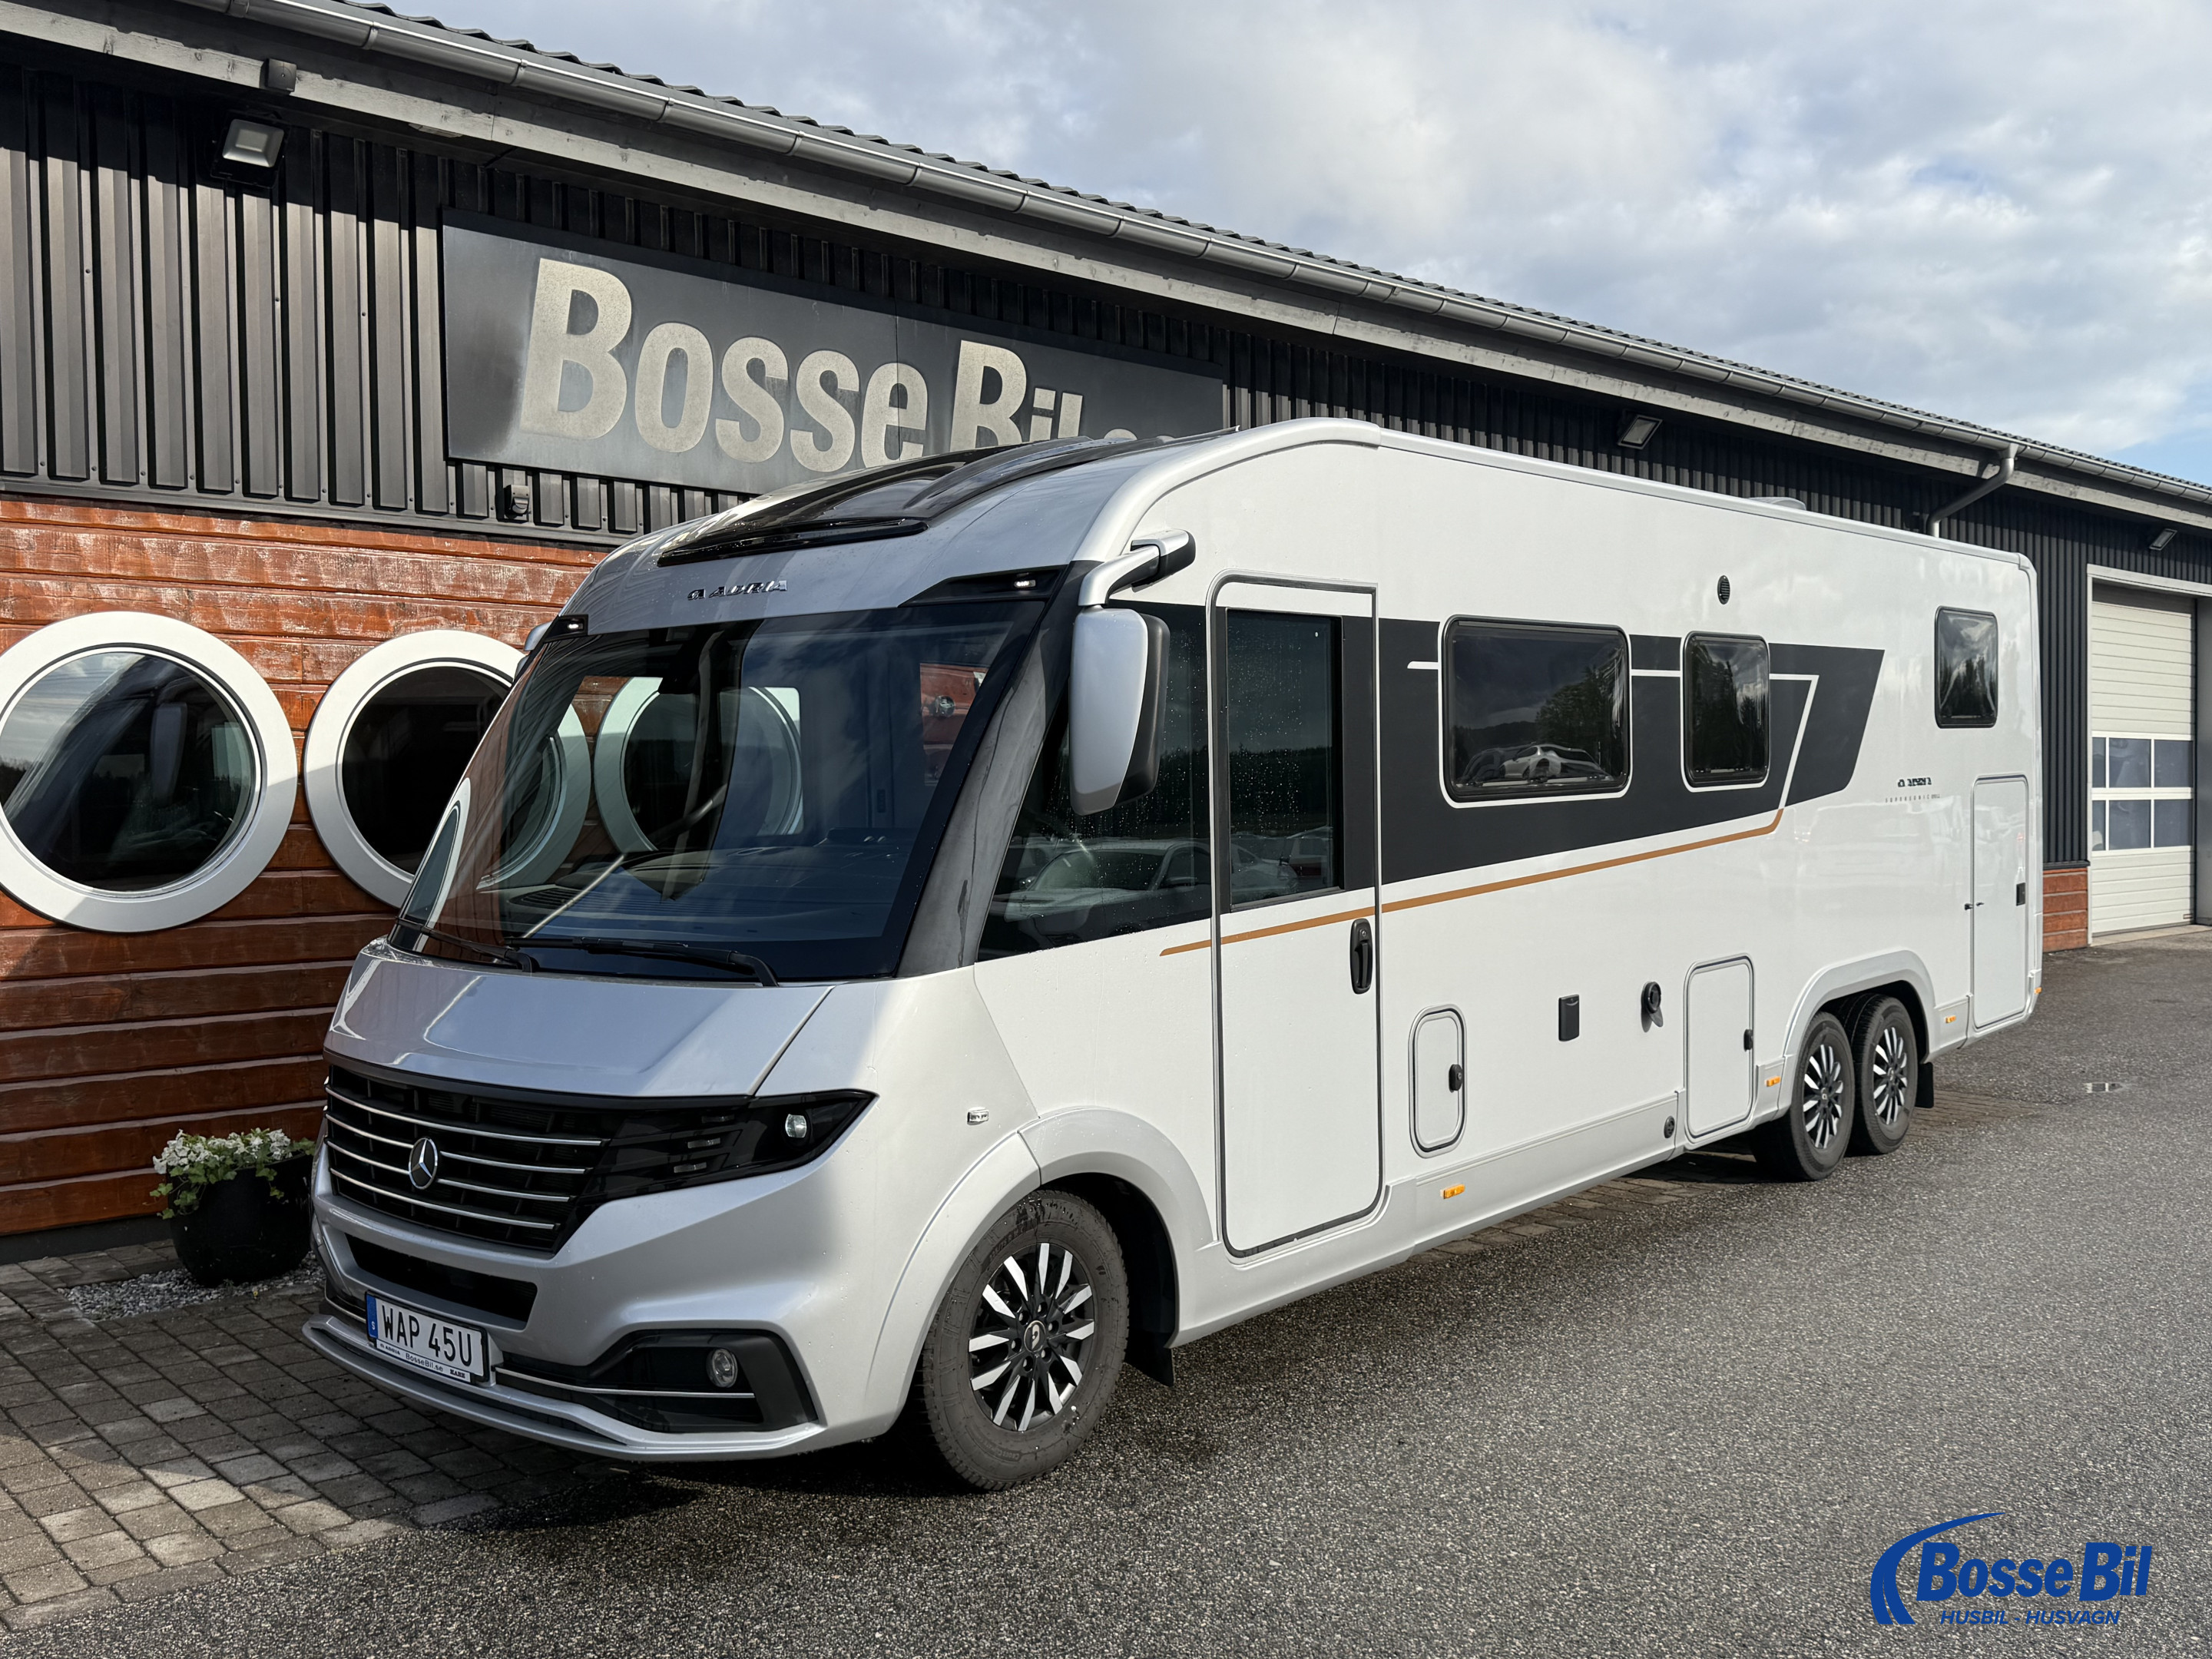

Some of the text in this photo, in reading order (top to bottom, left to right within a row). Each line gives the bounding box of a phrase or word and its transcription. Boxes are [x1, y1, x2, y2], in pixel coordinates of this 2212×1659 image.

[519, 257, 928, 472] Bosse
[709, 580, 787, 598] ADRIA
[371, 1321, 376, 1330] S
[382, 1305, 472, 1366] WAP 45U
[406, 1353, 443, 1372] BosseBil.se
